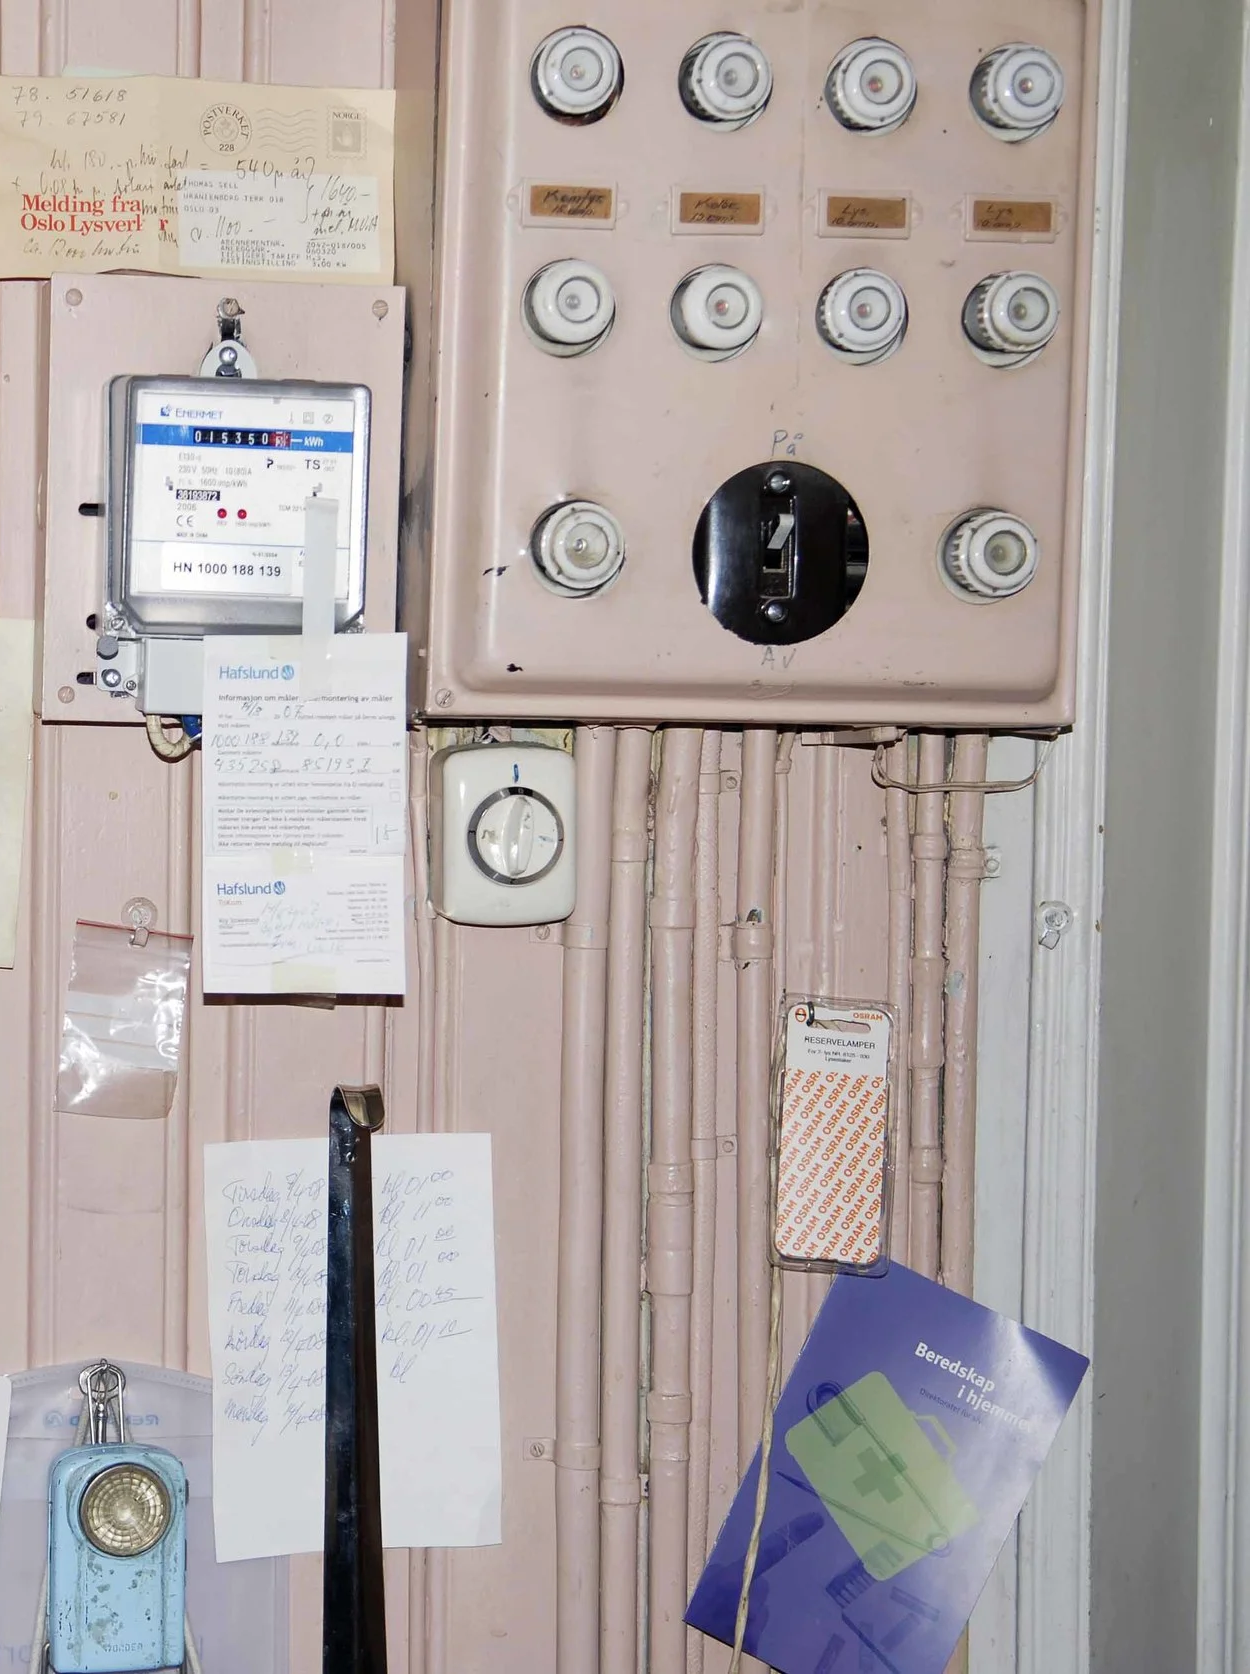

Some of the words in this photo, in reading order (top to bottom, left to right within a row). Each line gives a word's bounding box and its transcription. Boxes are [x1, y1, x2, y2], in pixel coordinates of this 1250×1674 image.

[66, 87, 127, 102] 51618
[67, 111, 126, 126] 67581
[202, 105, 250, 139] POSTVERKET
[332, 111, 361, 120] NORGE
[219, 144, 235, 152] 228
[20, 213, 65, 231] Oslo
[22, 194, 105, 216] Melding
[112, 195, 141, 213] fra
[304, 436, 324, 447] kWh
[305, 459, 321, 470] TS
[173, 562, 192, 573] HN
[197, 563, 227, 574] 1000
[233, 565, 254, 576] 188
[259, 566, 281, 577] 139
[219, 665, 279, 681] Hafslund
[217, 881, 272, 896] Hafslund
[853, 1012, 883, 1021] OSRAM
[804, 1036, 876, 1050] RESERVELAMPER
[800, 1084, 827, 1119] OSRAM
[824, 1074, 850, 1109] OSRAM
[847, 1090, 873, 1125] OSRAM
[798, 1110, 826, 1145] OSRAM
[823, 1100, 849, 1135] OSRAM
[845, 1116, 872, 1150] OSRAM
[797, 1136, 825, 1171] OSRAM
[821, 1126, 848, 1161] OSRAM
[844, 1142, 870, 1177] OSRAM
[796, 1163, 822, 1198] OSRAM
[820, 1152, 847, 1187] OSRAM
[842, 1168, 869, 1204] OSRAM
[794, 1189, 821, 1224] OSRAM
[818, 1178, 846, 1214] OSRAM
[841, 1194, 868, 1230] OSRAM
[793, 1215, 820, 1251] OSRAM
[817, 1205, 844, 1240] OSRAM
[840, 1220, 867, 1257] OSRAM
[915, 1342, 995, 1393] Beredskap
[957, 1385, 966, 1398] i
